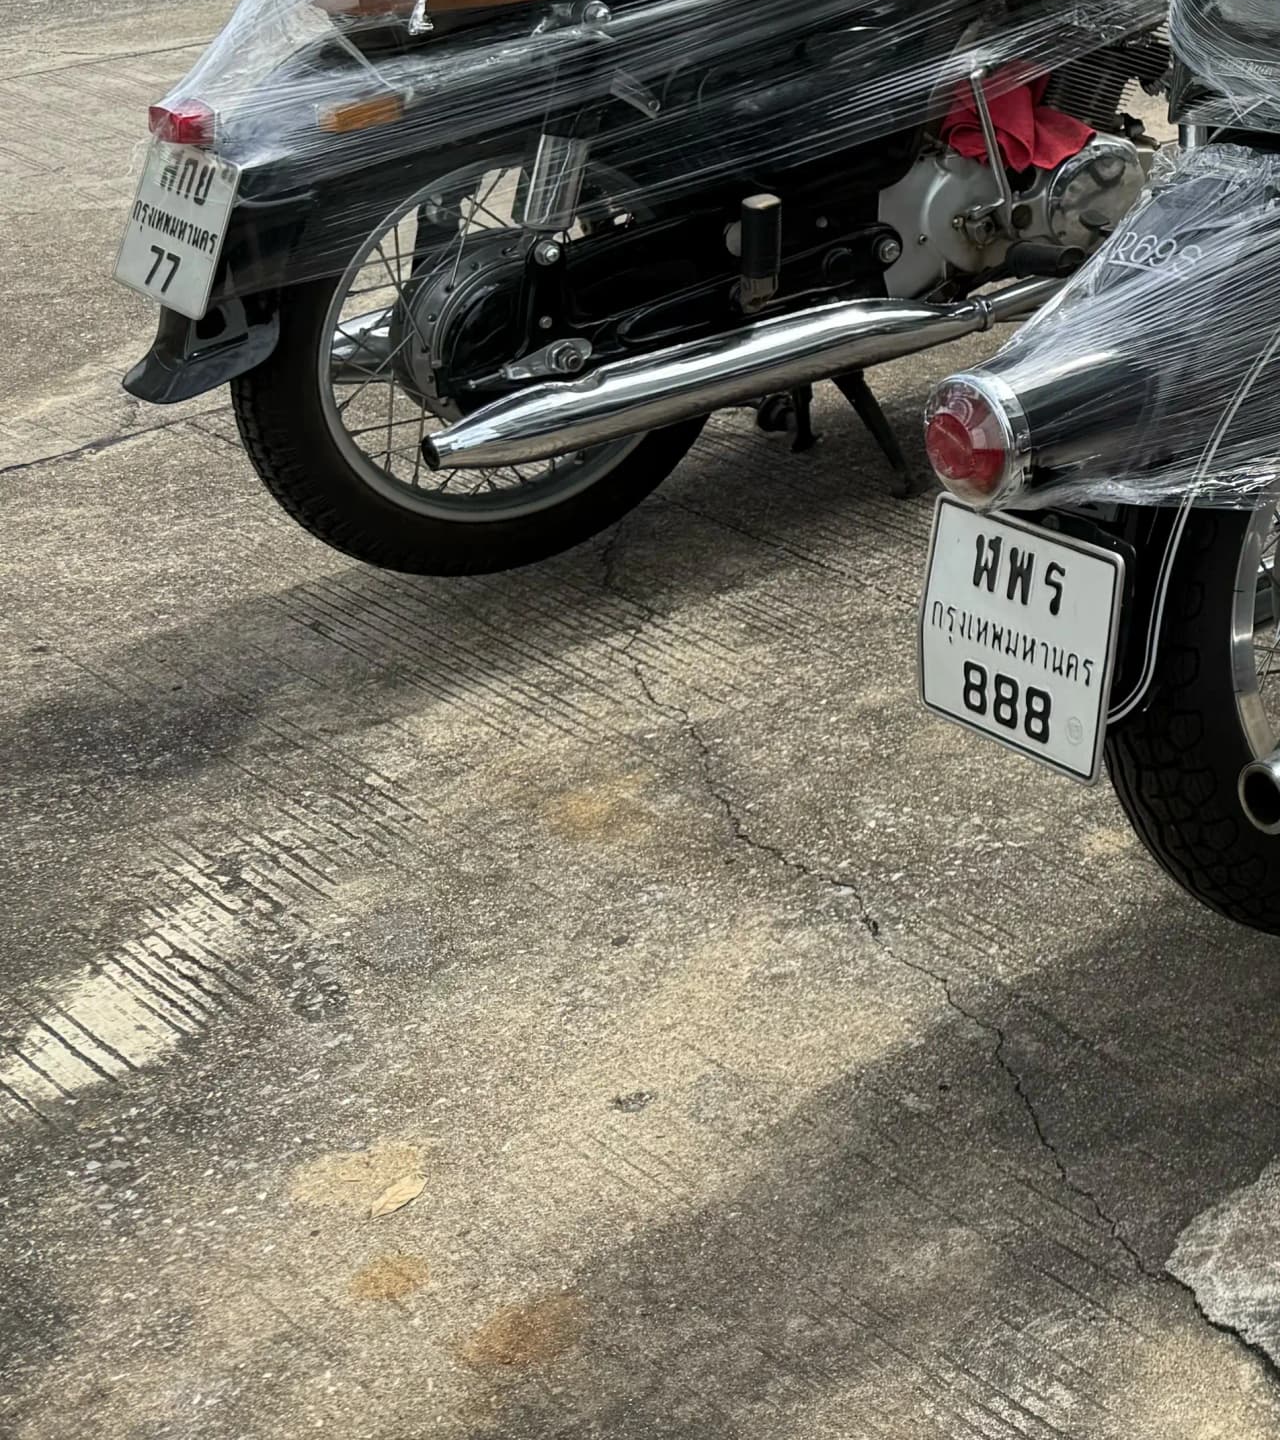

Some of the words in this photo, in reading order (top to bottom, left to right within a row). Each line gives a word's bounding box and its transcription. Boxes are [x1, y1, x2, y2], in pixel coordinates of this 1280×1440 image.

[132, 200, 218, 254] กรุงเทพมหานคร
[144, 244, 181, 293] 77
[932, 601, 1094, 687] กรุงเทพมหานคร
[963, 661, 1051, 744] 888
